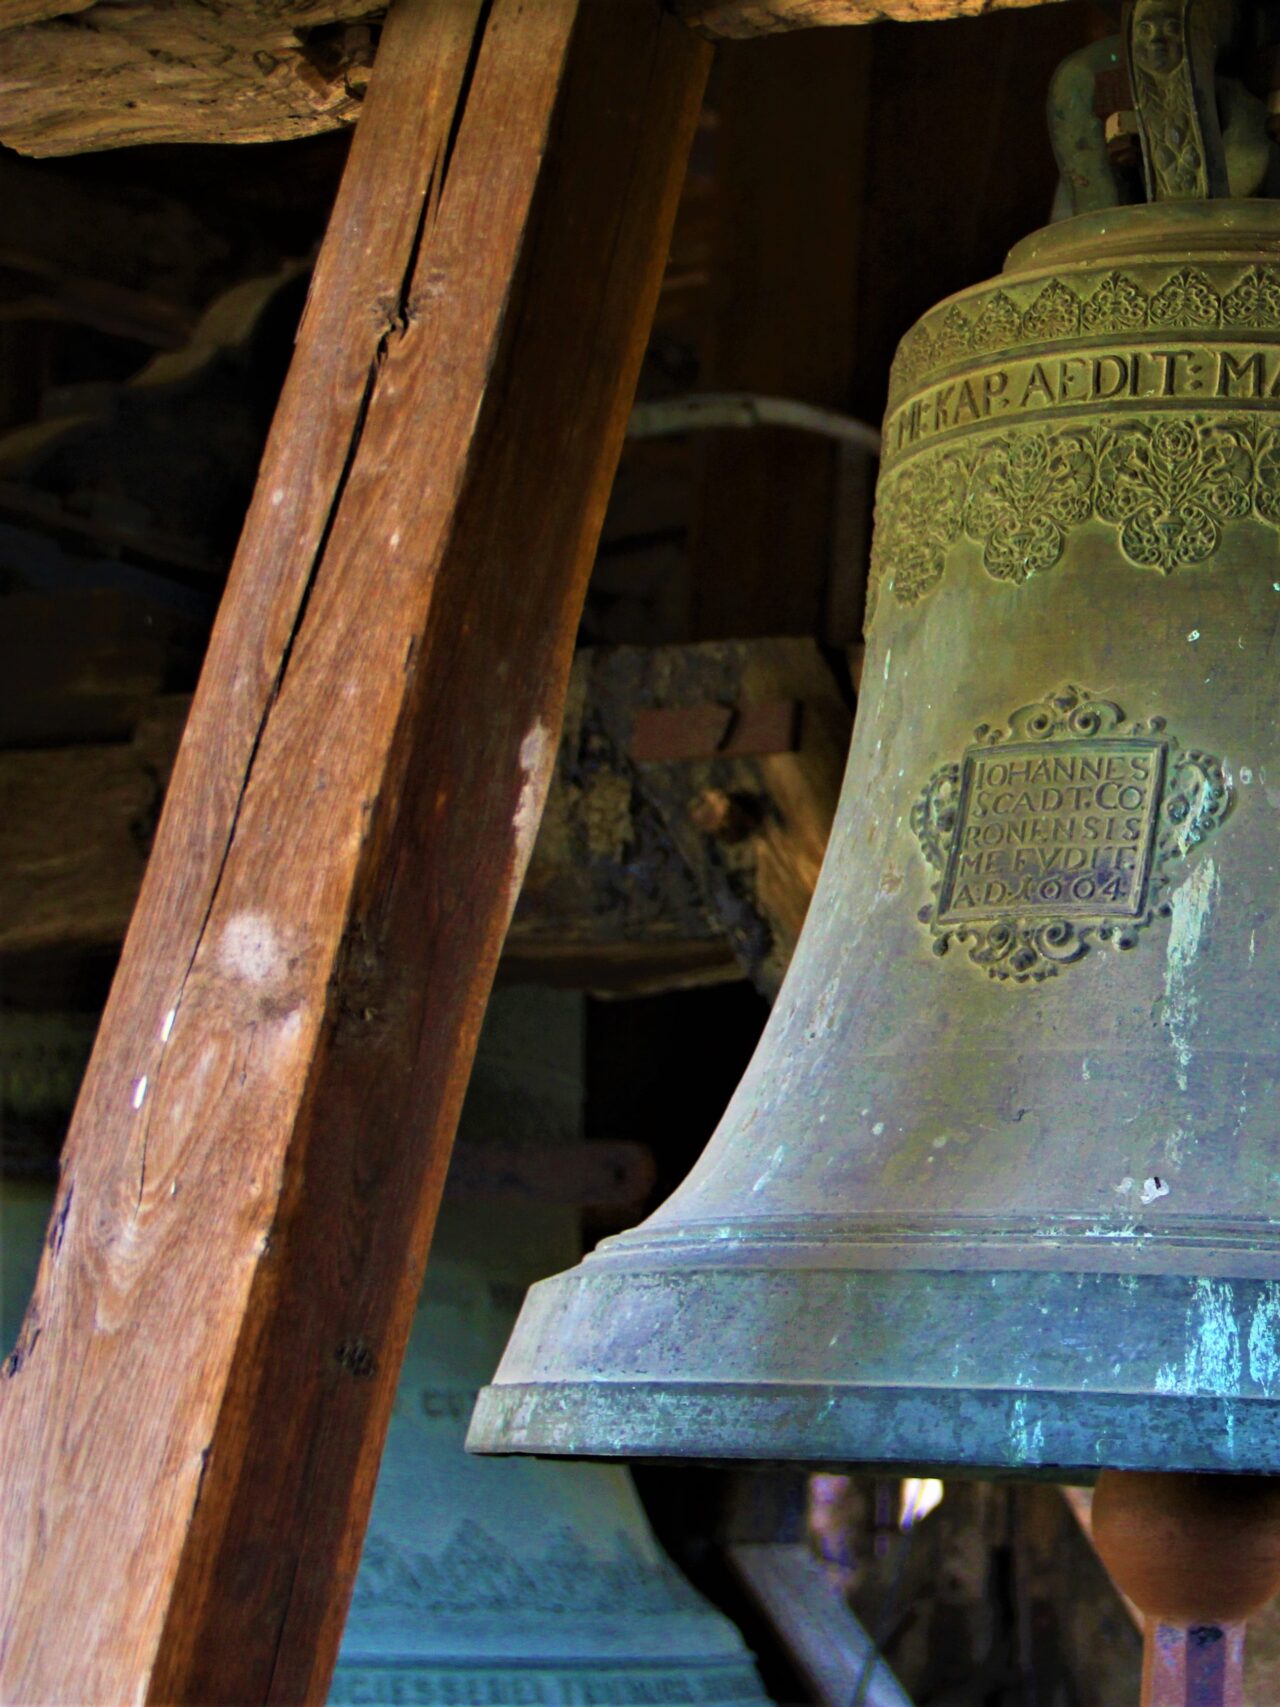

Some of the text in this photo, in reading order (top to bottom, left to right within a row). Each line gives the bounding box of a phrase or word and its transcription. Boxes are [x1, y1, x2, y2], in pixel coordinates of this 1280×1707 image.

[976, 756, 1149, 789] IOHANNES
[964, 816, 1142, 848] RONENSIS
[959, 851, 1003, 877] ME
